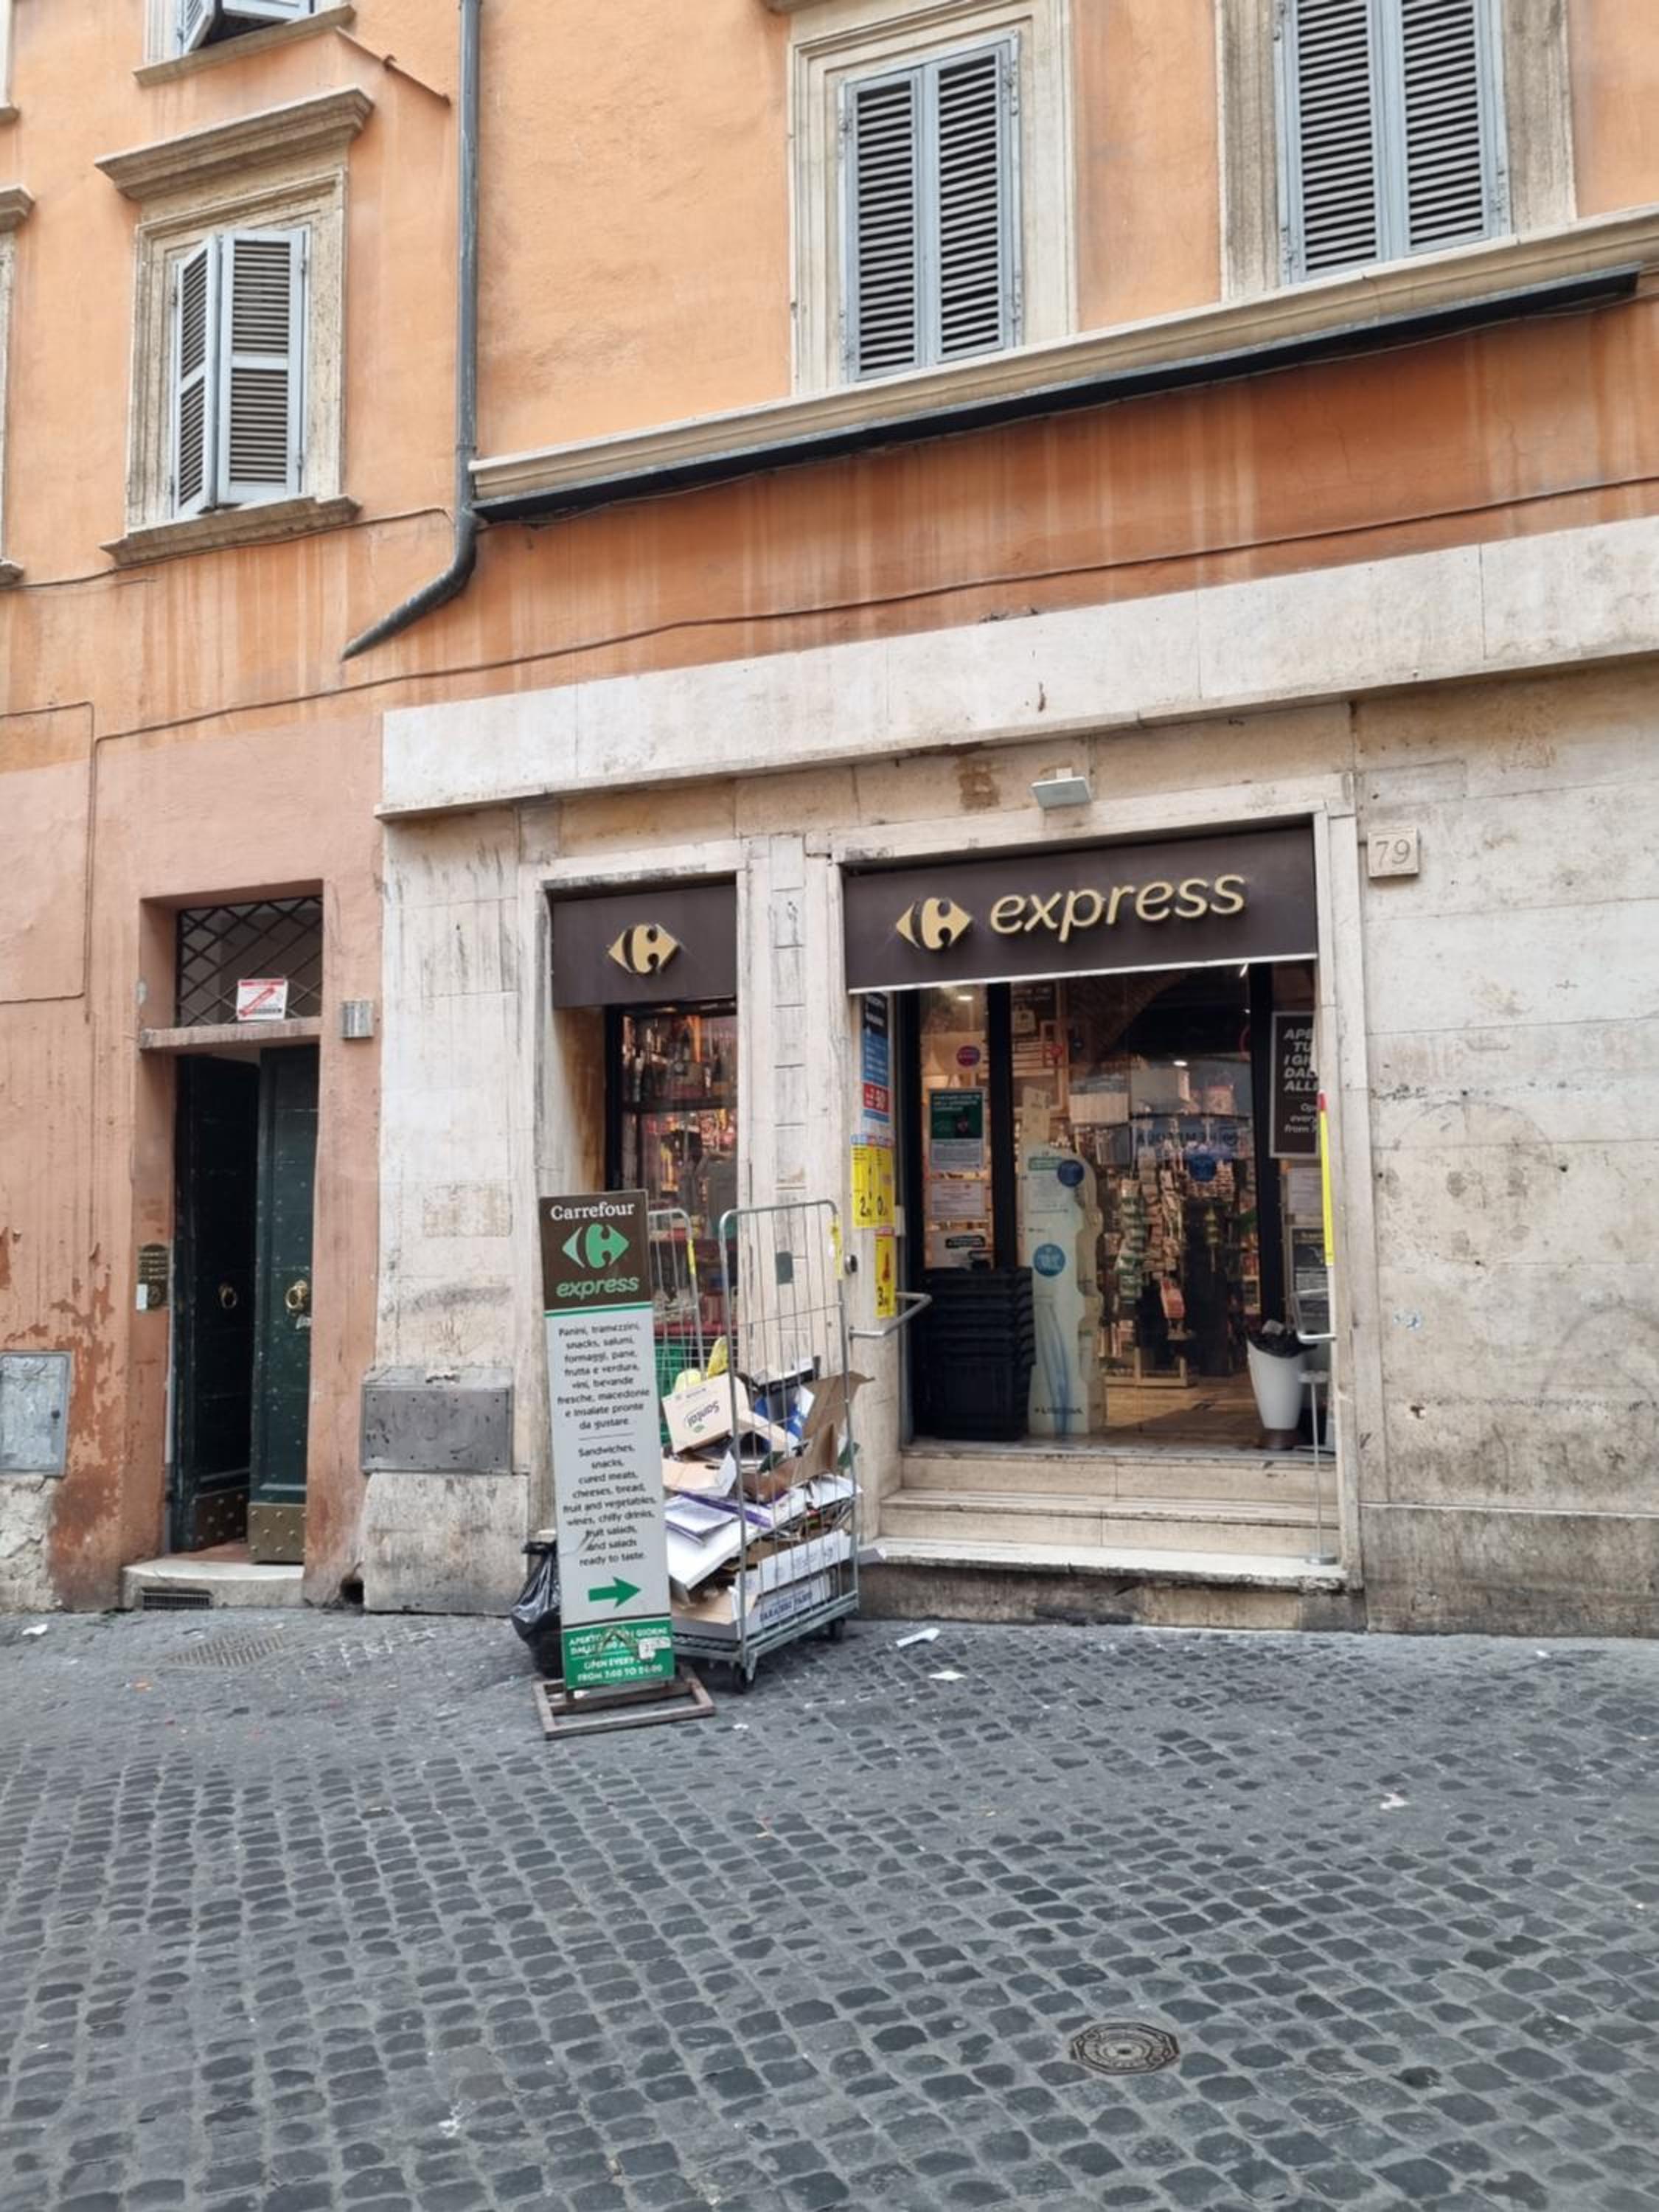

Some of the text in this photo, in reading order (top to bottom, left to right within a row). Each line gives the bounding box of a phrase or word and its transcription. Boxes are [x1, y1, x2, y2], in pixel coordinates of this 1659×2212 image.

[1375, 838, 1410, 869] 79
[990, 874, 1245, 942] express
[550, 1201, 635, 1221] Carrefour
[556, 1276, 639, 1300] express
